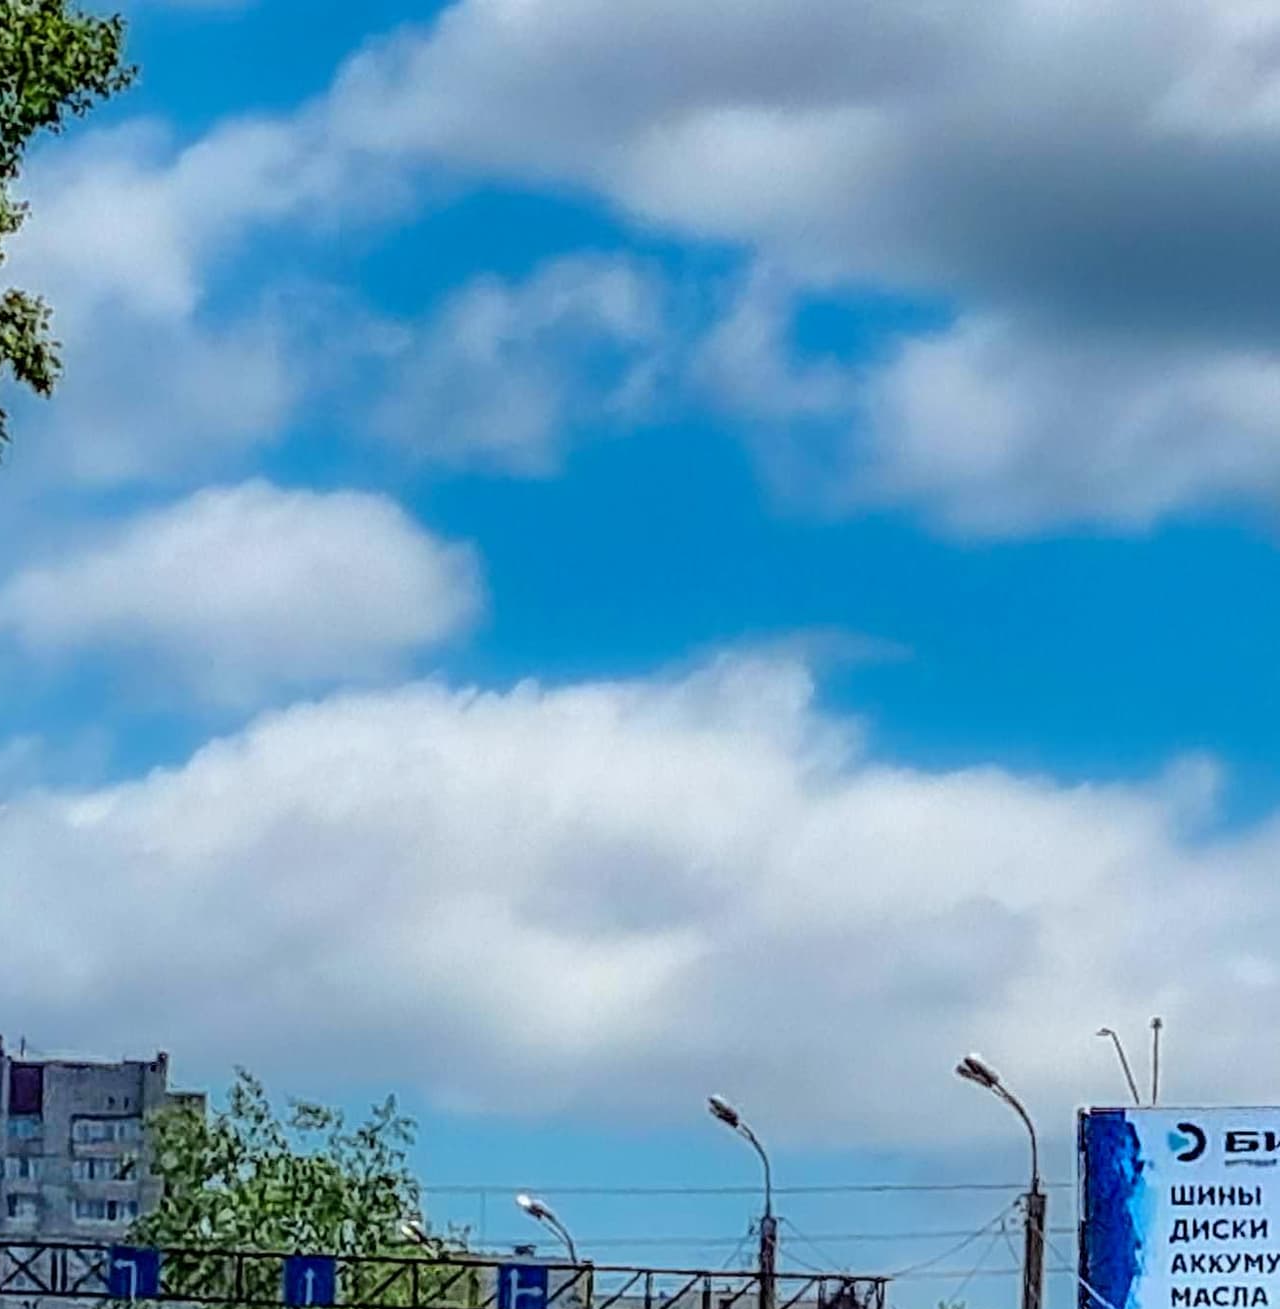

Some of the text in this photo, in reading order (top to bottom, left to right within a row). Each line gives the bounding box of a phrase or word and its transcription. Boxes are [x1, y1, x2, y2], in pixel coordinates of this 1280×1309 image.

[1170, 1185, 1262, 1206] ШИНЫ
[1169, 1218, 1268, 1244] ДИСКИ
[1170, 1286, 1269, 1308] МАСЛА
